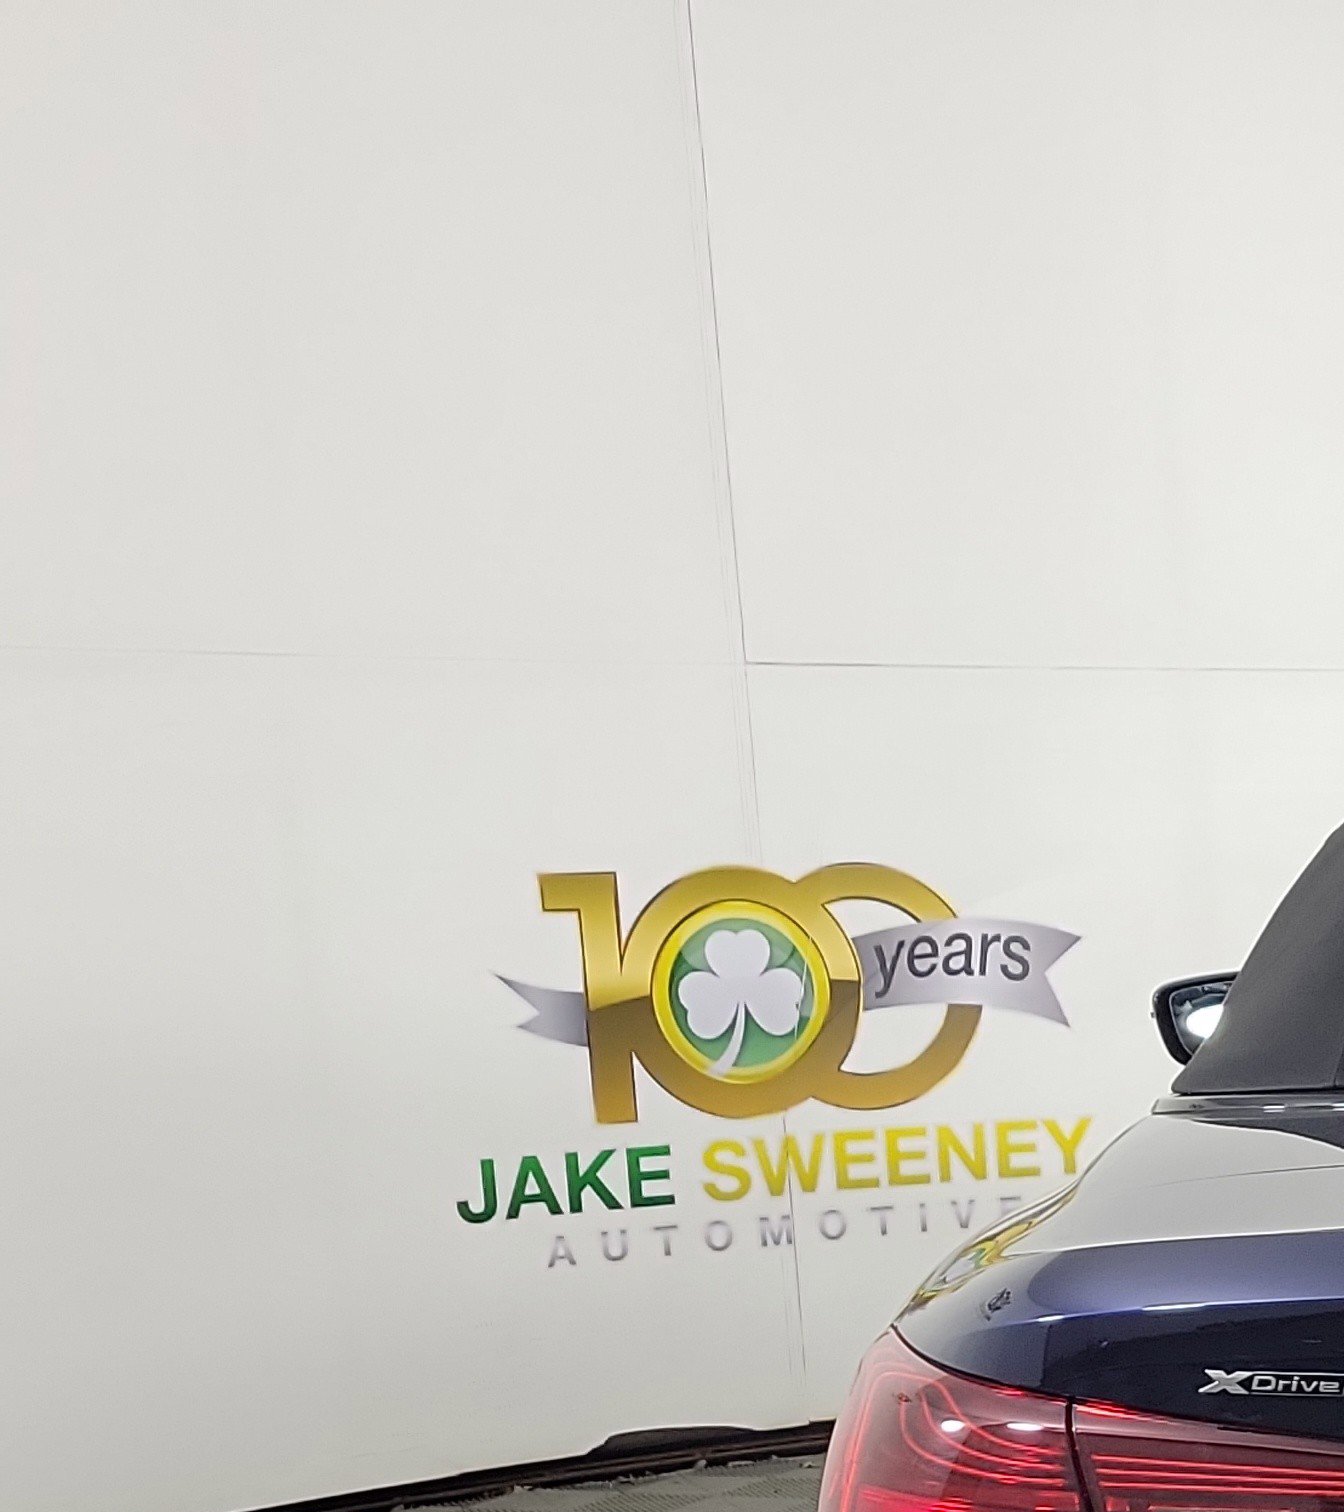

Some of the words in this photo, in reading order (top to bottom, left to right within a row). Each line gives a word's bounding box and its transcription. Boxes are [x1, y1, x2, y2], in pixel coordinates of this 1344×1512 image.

[537, 862, 982, 1124] 100
[873, 929, 1031, 998] years
[456, 1144, 676, 1224] JAKE
[702, 1117, 1092, 1201] SWEENEY
